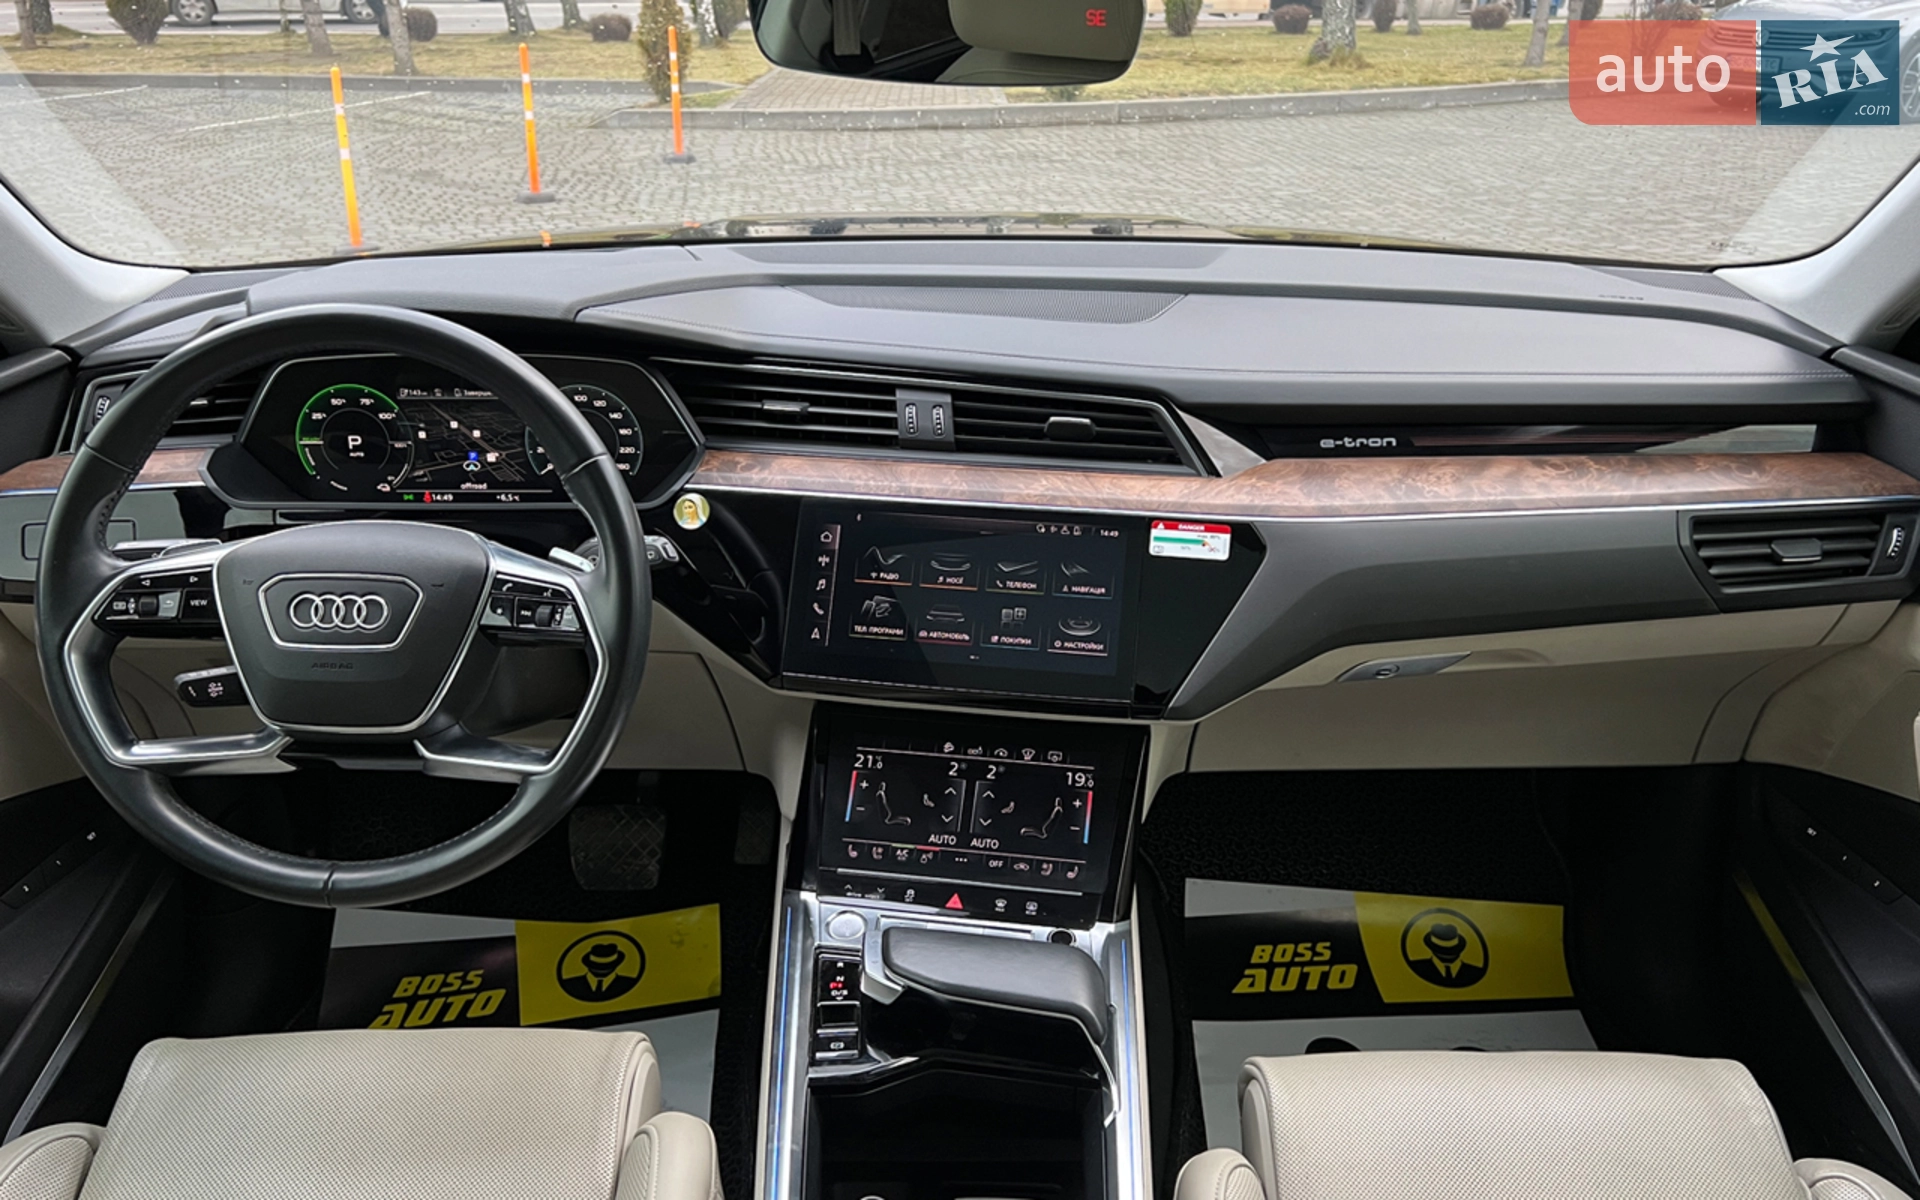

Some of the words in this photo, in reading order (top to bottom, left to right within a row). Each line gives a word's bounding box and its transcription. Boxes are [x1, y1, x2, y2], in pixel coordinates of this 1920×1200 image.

[1086, 9, 1107, 26] SE
[347, 435, 362, 449] P
[1320, 437, 1397, 448] e-tron
[1100, 529, 1119, 537] 14:49
[1006, 580, 1037, 589] ТЕЛЕФОН
[928, 834, 957, 845] AUTO
[970, 837, 999, 849] AUTO
[988, 860, 1004, 868] OFF
[1250, 942, 1331, 964] BOSS
[392, 969, 485, 998] BOSS
[1231, 964, 1358, 993] AUTO
[367, 988, 506, 1029] AUTO
